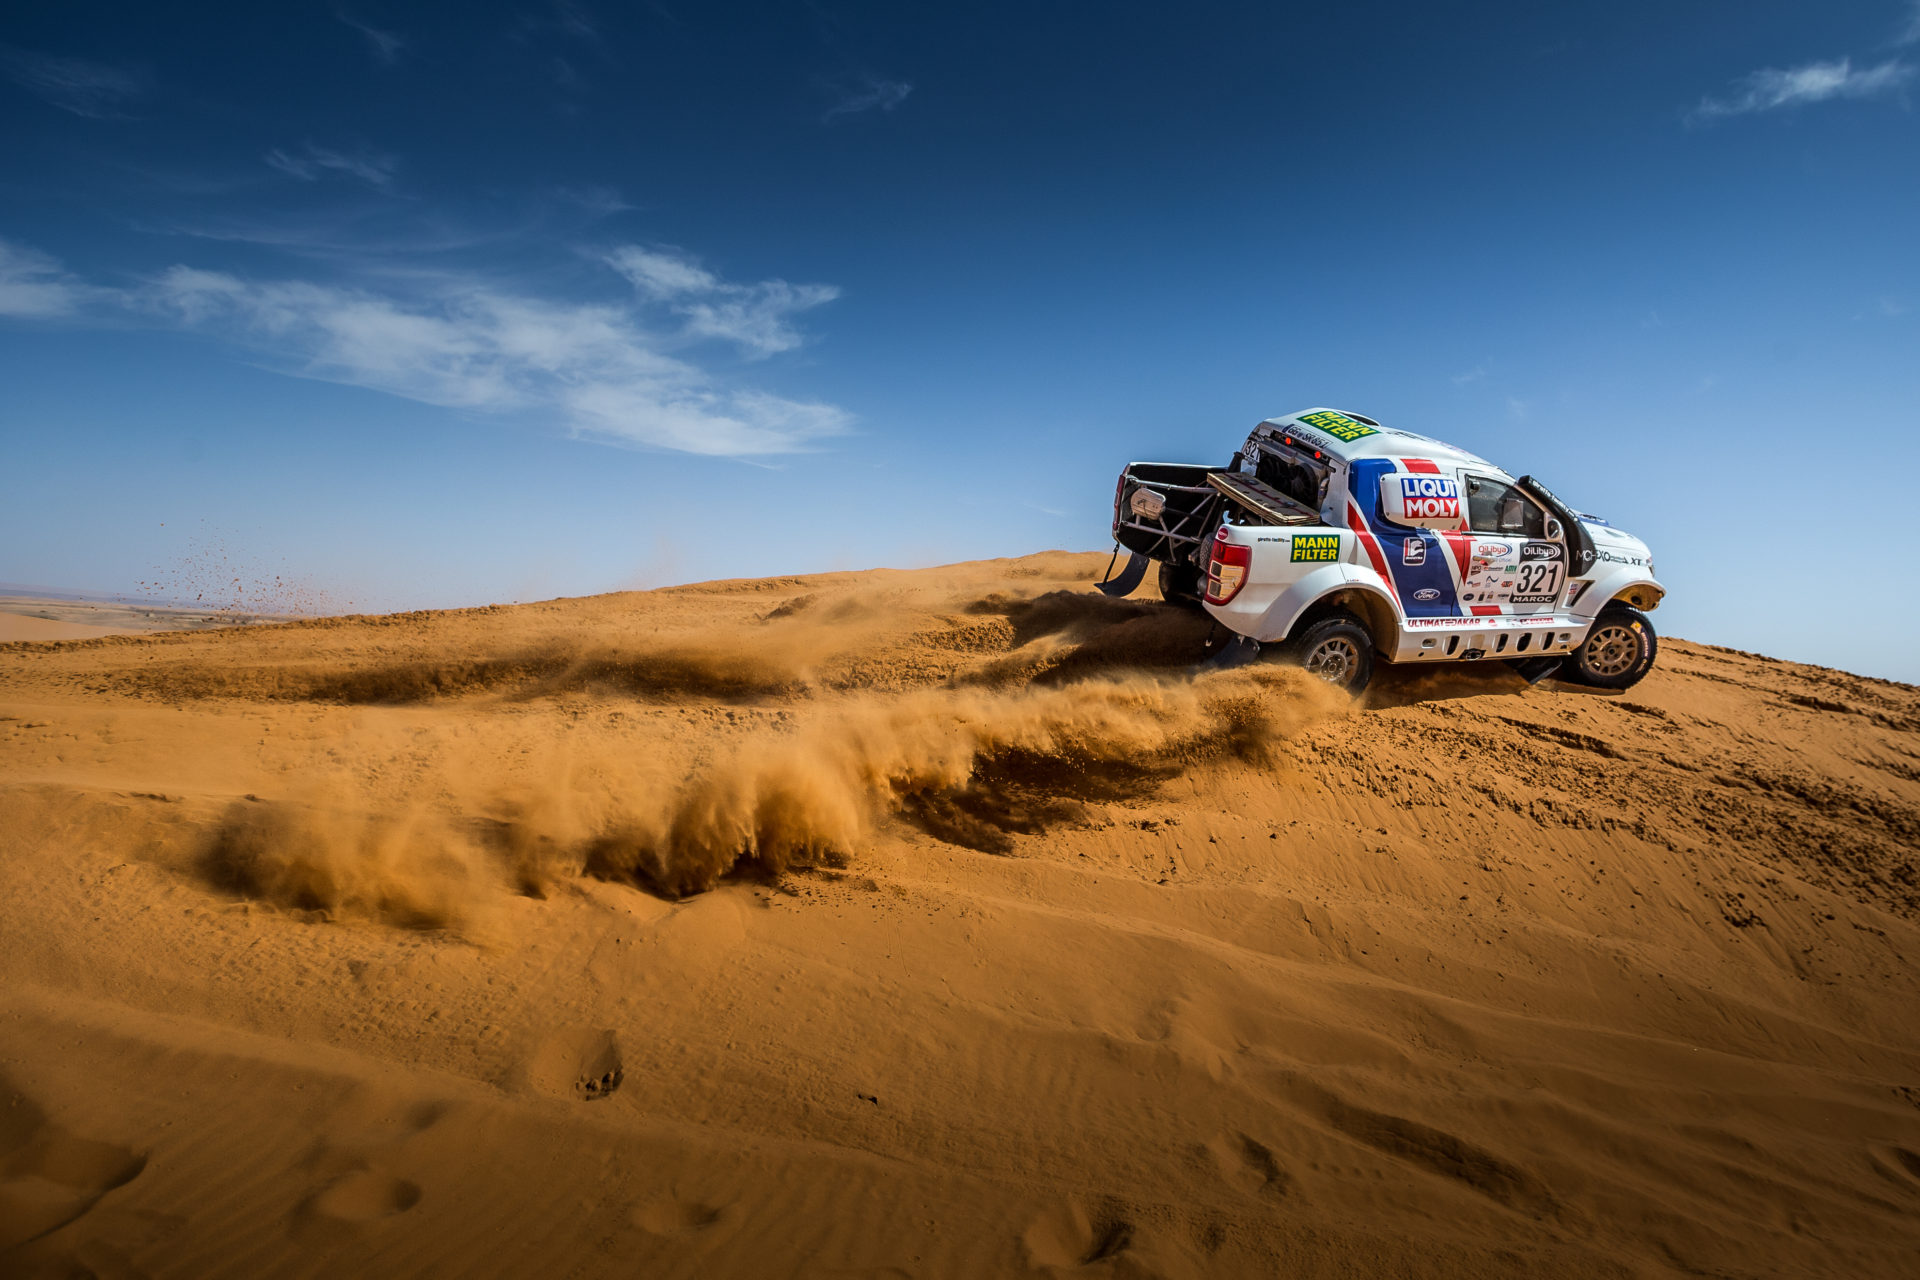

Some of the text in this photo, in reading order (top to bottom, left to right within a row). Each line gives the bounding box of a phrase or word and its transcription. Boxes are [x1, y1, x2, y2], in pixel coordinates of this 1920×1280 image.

[1303, 414, 1360, 440] FILTER
[1319, 411, 1375, 435] MANN
[1403, 480, 1456, 498] LIQUI
[1406, 499, 1458, 517] MOLY
[1294, 537, 1338, 549] MANN
[1293, 549, 1337, 560] FILTER
[1516, 564, 1558, 593] 321
[1418, 590, 1436, 599] Ford
